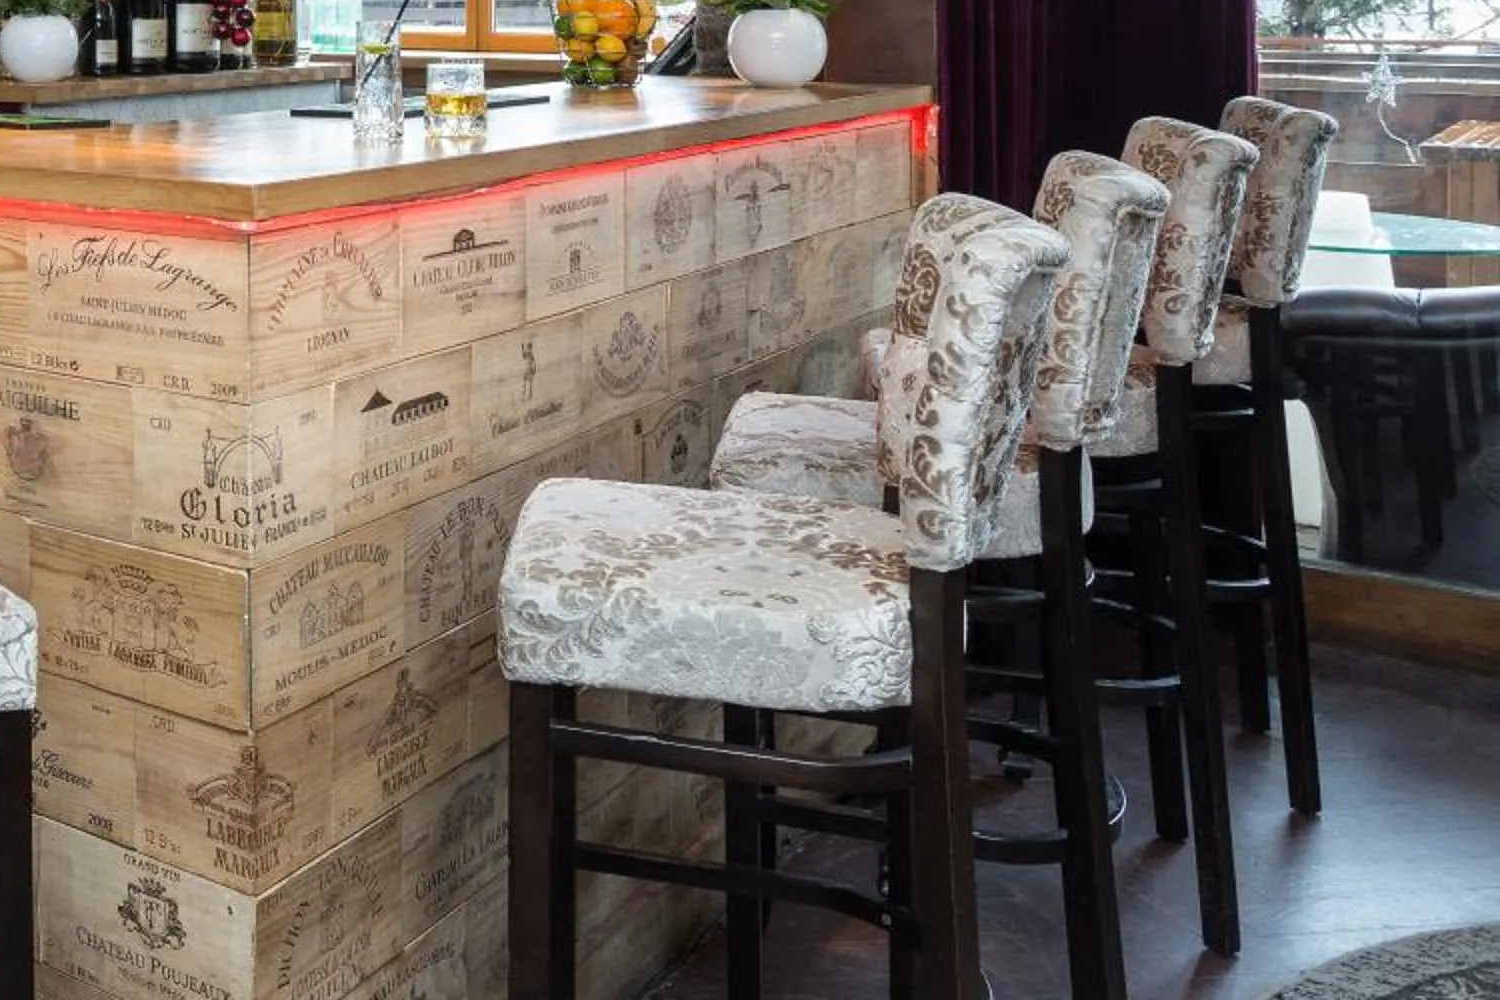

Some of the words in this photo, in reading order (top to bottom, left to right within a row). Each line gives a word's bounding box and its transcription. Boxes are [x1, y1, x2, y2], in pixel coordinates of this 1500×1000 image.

[140, 240, 239, 313] Lagrange
[179, 487, 297, 529] Gloria
[199, 526, 258, 551] JULIEN
[268, 557, 320, 616] CHATEAU
[75, 925, 146, 969] CHATEAU
[150, 956, 232, 999] POUJEAUX
